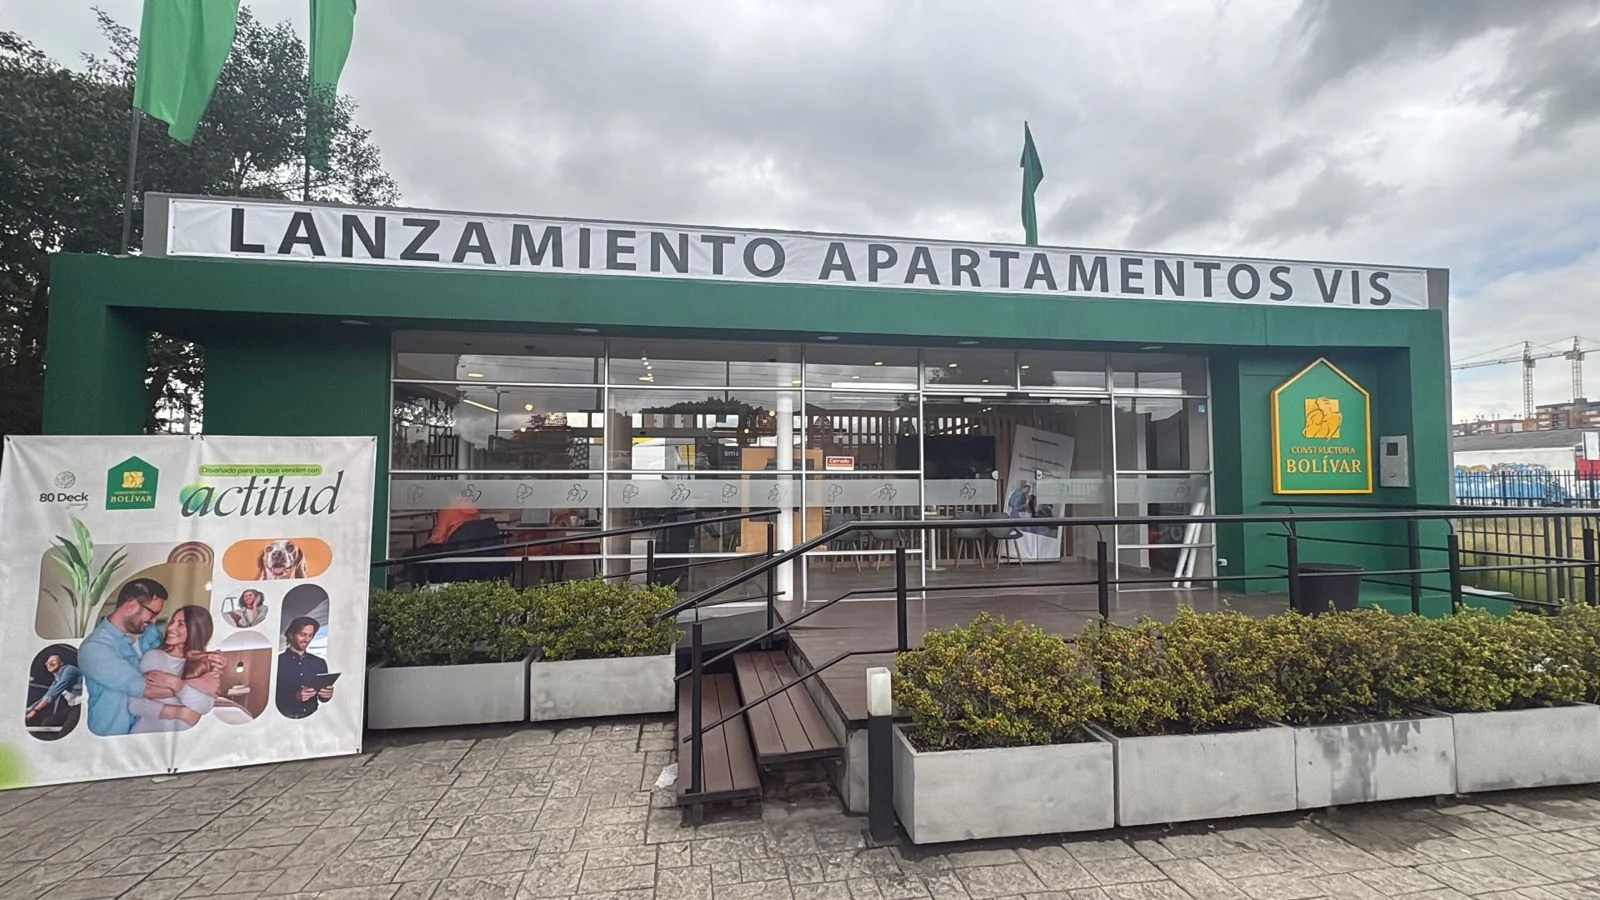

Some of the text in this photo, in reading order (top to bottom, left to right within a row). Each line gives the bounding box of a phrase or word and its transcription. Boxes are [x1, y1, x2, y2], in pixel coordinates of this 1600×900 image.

[230, 207, 1392, 306] LANZAMIENTO APARTAMENTOS VIS
[1291, 446, 1356, 454] CONSTRUCTORA
[1286, 455, 1362, 473] BOLÍVAR
[201, 466, 237, 474] Diseñado
[237, 467, 254, 475] para
[254, 466, 266, 474] los
[266, 467, 280, 475] que
[280, 466, 307, 474] venden
[39, 491, 89, 503] 80 Deck
[110, 494, 153, 503] BOLÍVAR
[181, 469, 345, 518] actitud
